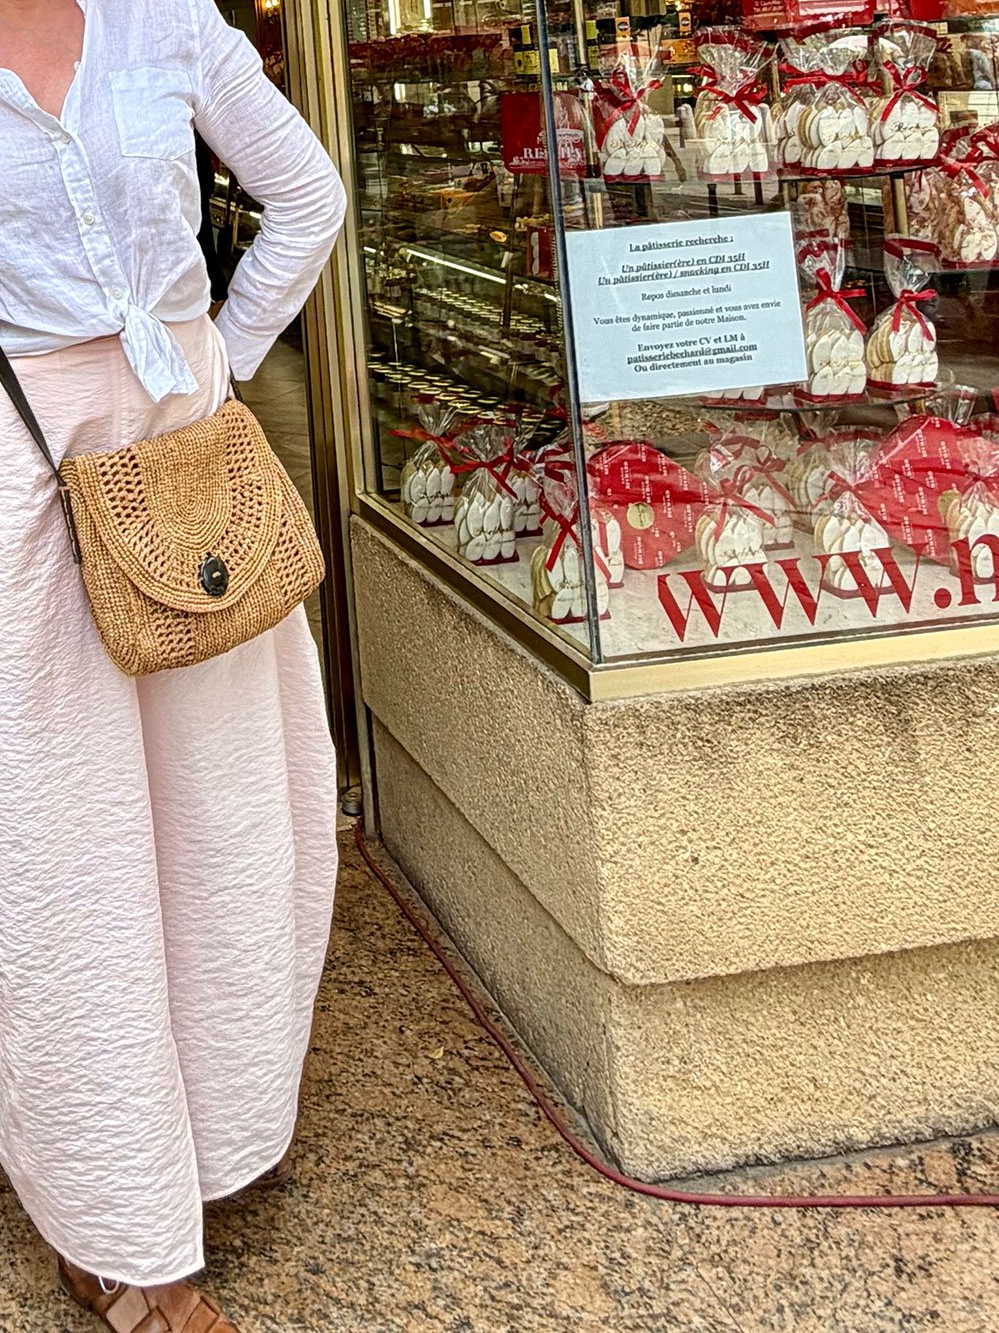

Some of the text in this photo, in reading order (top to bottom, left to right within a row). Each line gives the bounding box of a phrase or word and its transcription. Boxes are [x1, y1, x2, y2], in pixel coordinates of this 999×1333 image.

[629, 243, 640, 252] La
[642, 239, 683, 251] pâtisserie
[685, 235, 729, 247] recherche
[622, 264, 634, 273] Un
[696, 257, 706, 265] en
[708, 255, 726, 264] CDI
[727, 253, 745, 264] 35H
[598, 276, 611, 286] Un
[680, 266, 719, 278] snacking
[733, 263, 750, 272] CDI
[751, 261, 770, 271] 35H
[641, 284, 732, 302] Repos dimanche et lundi
[593, 300, 781, 325] Vous êtes dynamique, passionné et vous avez envie
[631, 314, 747, 332] de faire partie de notre Maison.
[638, 343, 674, 352] Envoyez
[676, 339, 697, 348] votre
[699, 337, 712, 345] CV
[713, 336, 722, 344] et
[724, 333, 738, 342] LM
[634, 353, 753, 373] Ou directement au magasin
